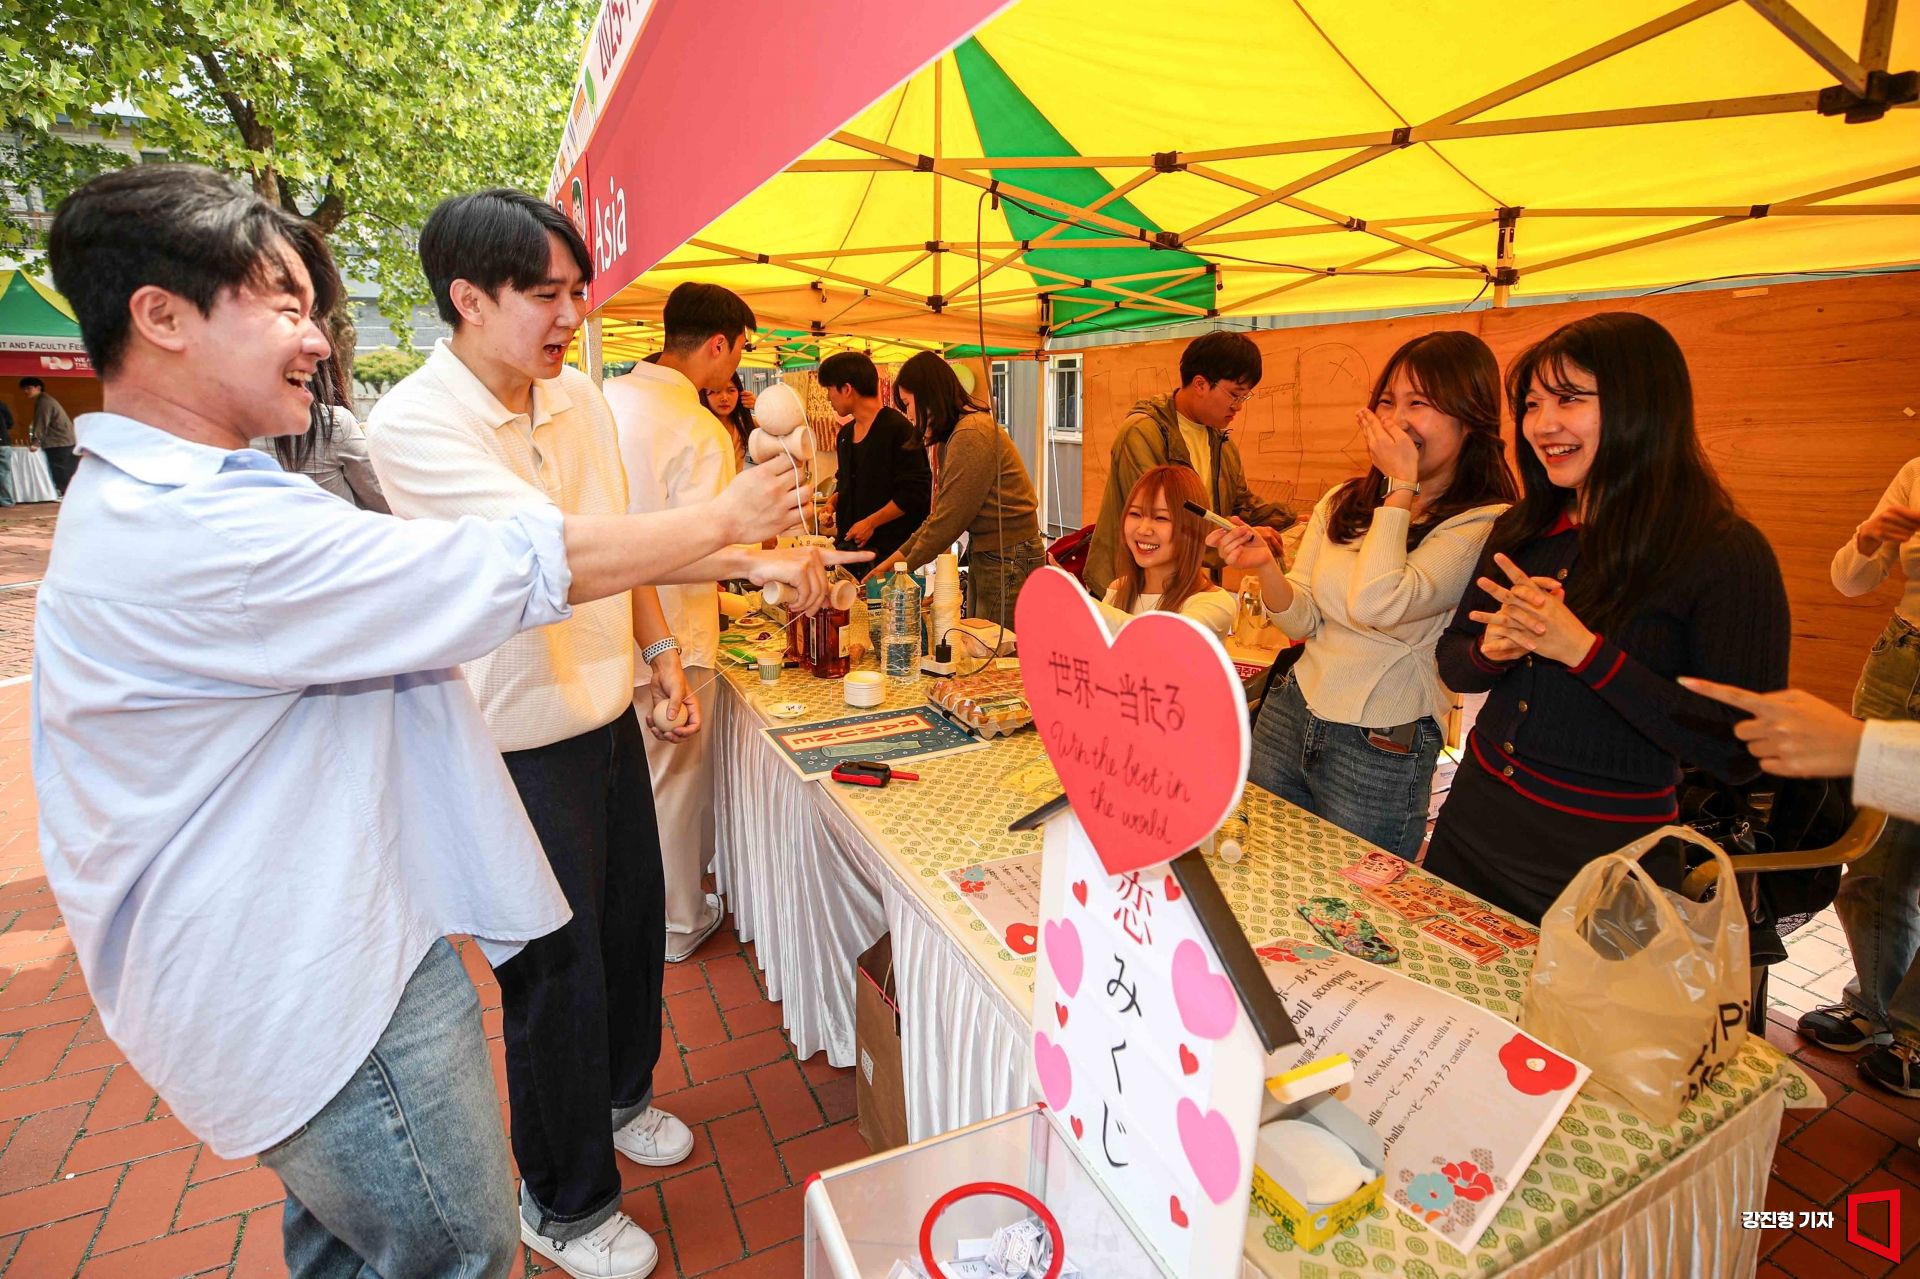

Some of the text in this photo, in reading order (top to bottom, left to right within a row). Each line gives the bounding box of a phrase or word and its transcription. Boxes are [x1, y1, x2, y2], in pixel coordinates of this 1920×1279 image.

[598, 0, 642, 81] 2025-1
[593, 176, 628, 279] Asia
[29, 342, 67, 350] FACULTY
[1049, 651, 1185, 734] 世界一当たる
[793, 719, 919, 746] RAMUNE
[1093, 736, 1118, 777] the
[1168, 771, 1191, 803] in
[1090, 781, 1172, 845] the world
[1312, 970, 1357, 1000] scooping
[1102, 871, 1153, 1168] 恋みくじ
[1351, 1012, 1396, 1070] え萌えきゅん券
[1364, 1016, 1425, 1088] Moe Moe Kyun ticket
[1368, 1107, 1383, 1128] alls
